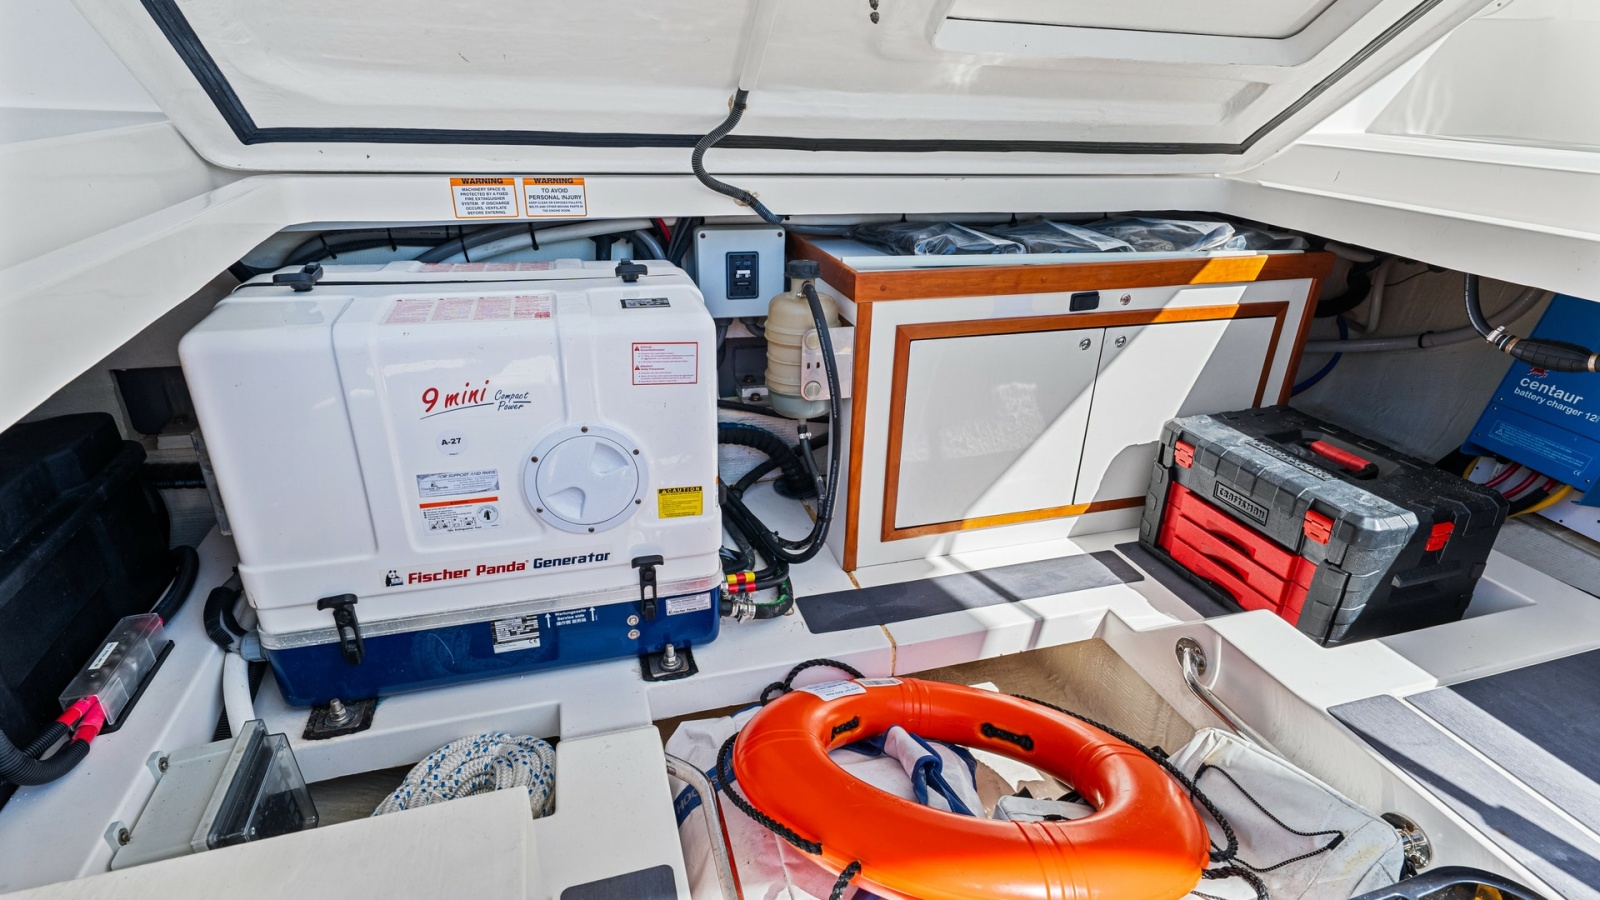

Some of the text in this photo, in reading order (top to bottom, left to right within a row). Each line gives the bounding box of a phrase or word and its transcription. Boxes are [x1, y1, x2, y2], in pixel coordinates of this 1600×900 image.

[422, 380, 490, 413] 9 mini
[494, 390, 529, 403] Compact
[1514, 387, 1546, 405] battery
[1547, 399, 1583, 418] charger
[1520, 377, 1583, 405] centaur
[497, 400, 524, 411] Power
[441, 437, 462, 446] A-27
[408, 568, 471, 585] Fischer
[533, 552, 610, 569] Generator
